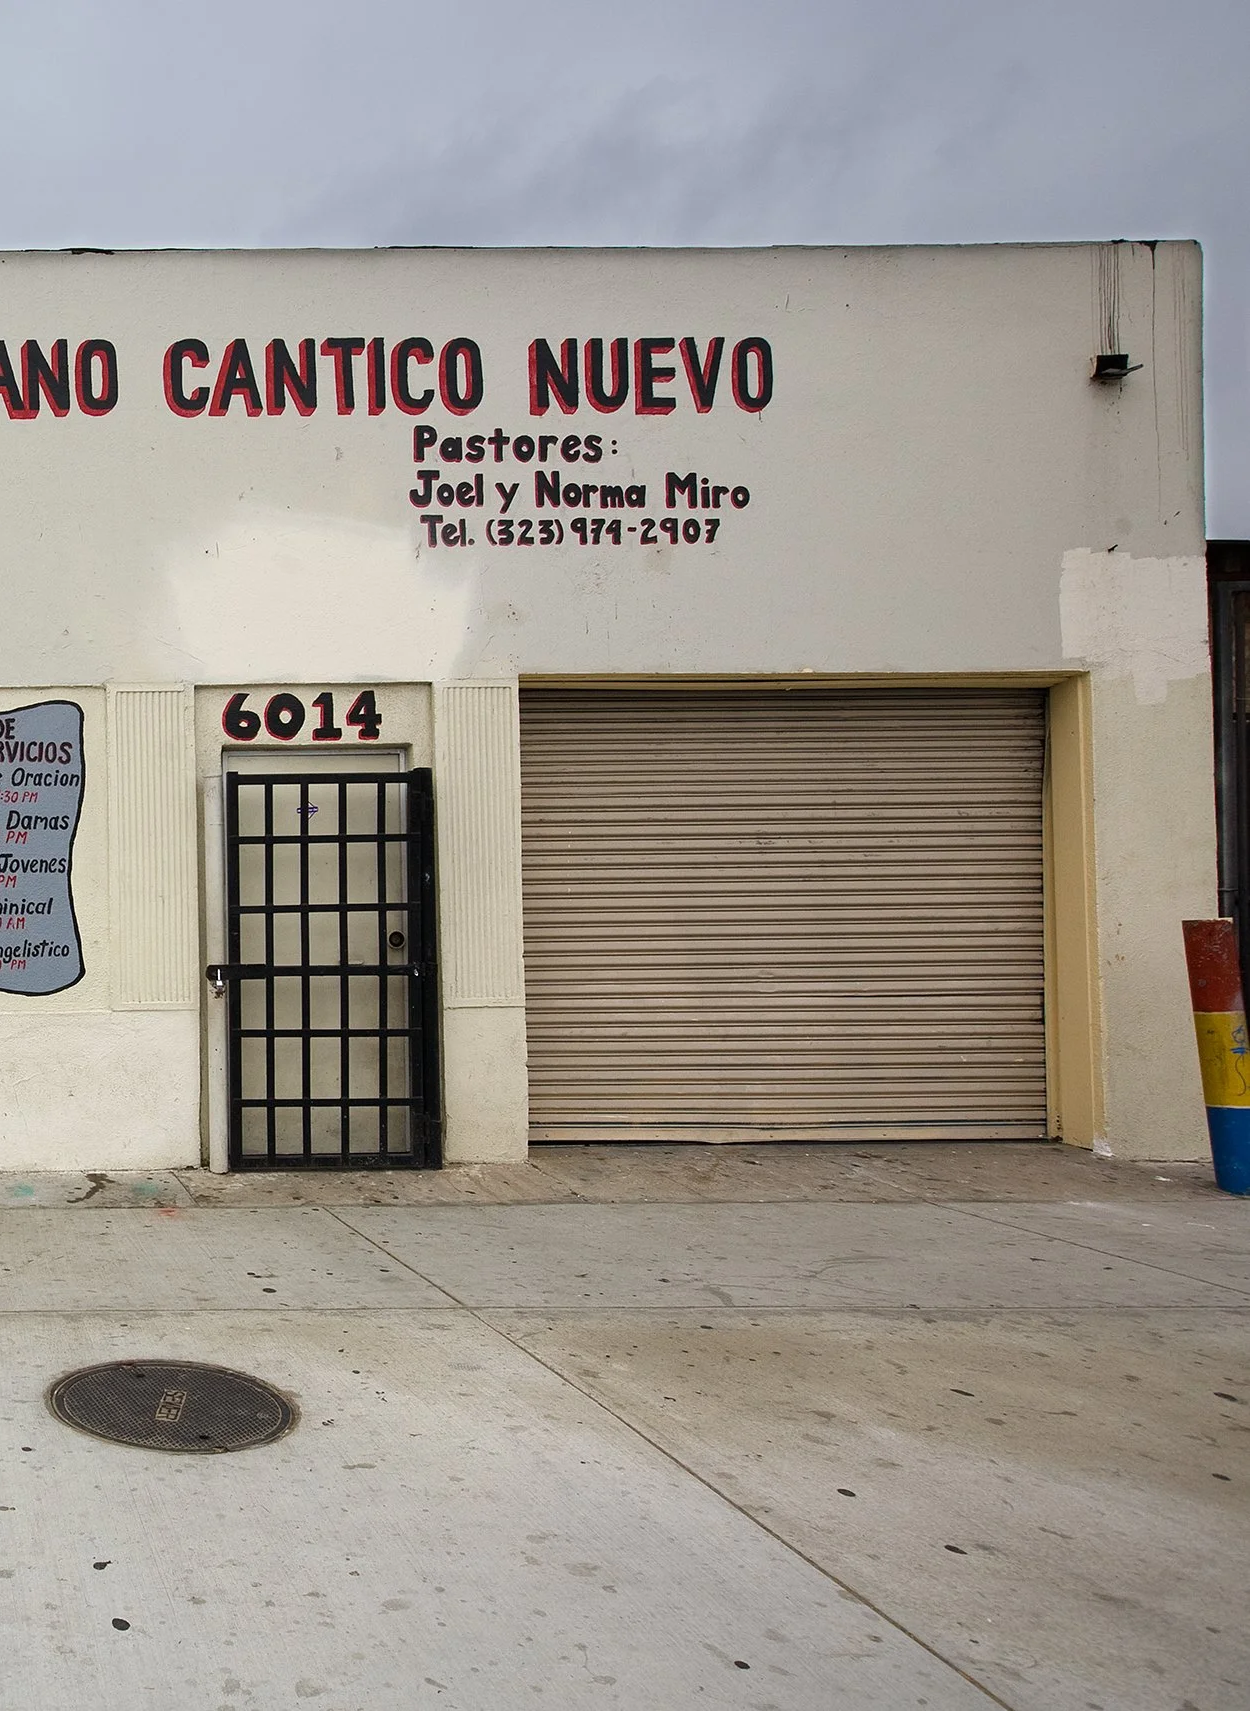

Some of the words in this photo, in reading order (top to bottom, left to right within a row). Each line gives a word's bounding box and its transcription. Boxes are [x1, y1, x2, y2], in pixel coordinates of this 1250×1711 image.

[162, 337, 483, 418] CANTICO
[529, 337, 774, 417] NUEVO
[413, 425, 618, 463] Pastores:
[409, 469, 484, 508] Joel
[495, 482, 519, 514] y
[534, 470, 646, 509] Norma
[665, 472, 751, 509] Miro
[420, 514, 475, 547] Tel.
[221, 690, 382, 741] 6014
[11, 768, 80, 787] Oracion
[21, 791, 38, 803] PM
[6, 810, 70, 830] Damas
[6, 830, 28, 844] PM
[6, 916, 25, 930] AM
[10, 960, 26, 970] PM
